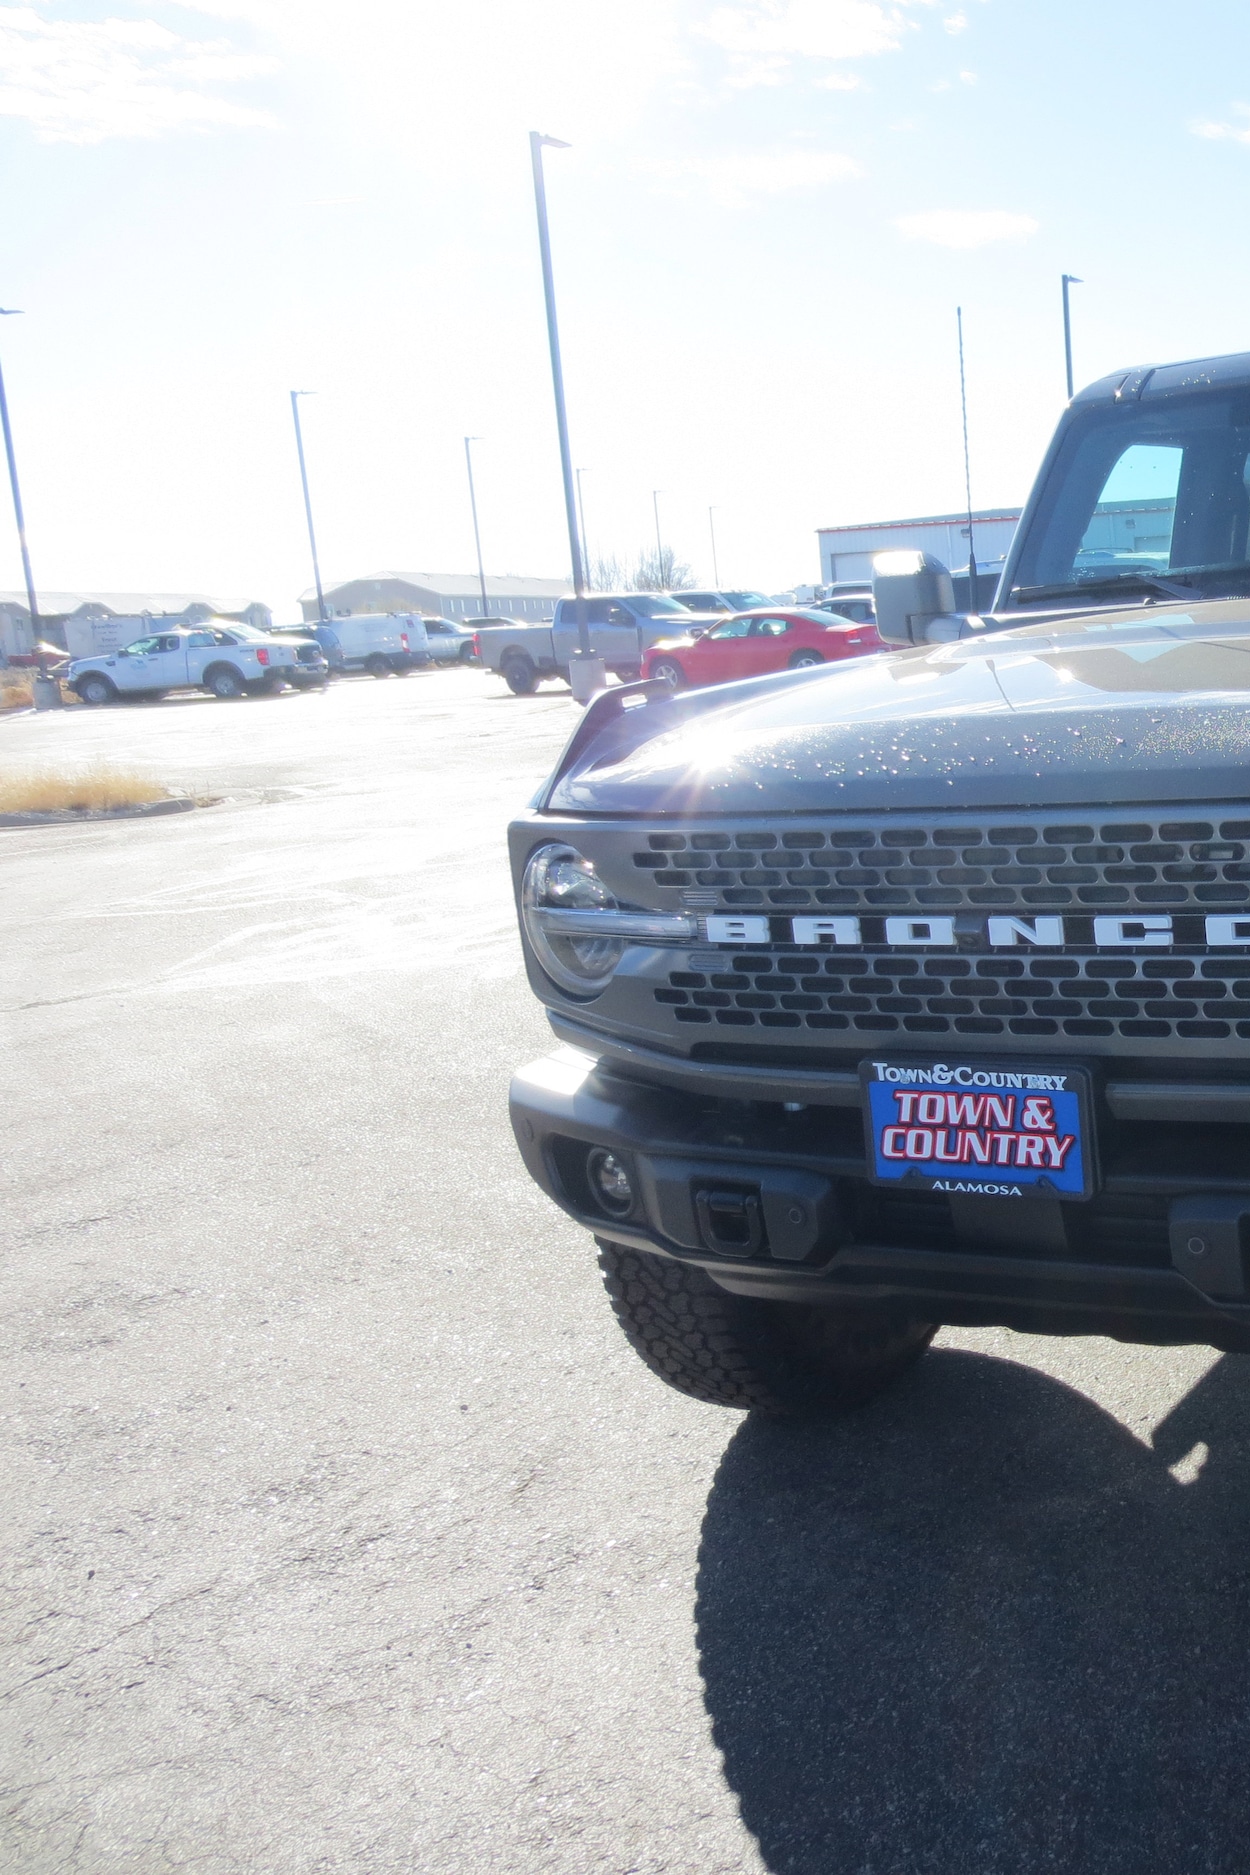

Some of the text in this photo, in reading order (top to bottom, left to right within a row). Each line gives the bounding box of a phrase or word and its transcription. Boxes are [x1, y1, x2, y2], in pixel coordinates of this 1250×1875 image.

[893, 1089, 1056, 1132] TOWN &
[882, 1125, 1075, 1168] COUNTRY
[932, 1180, 1023, 1197] ALAMOSA
